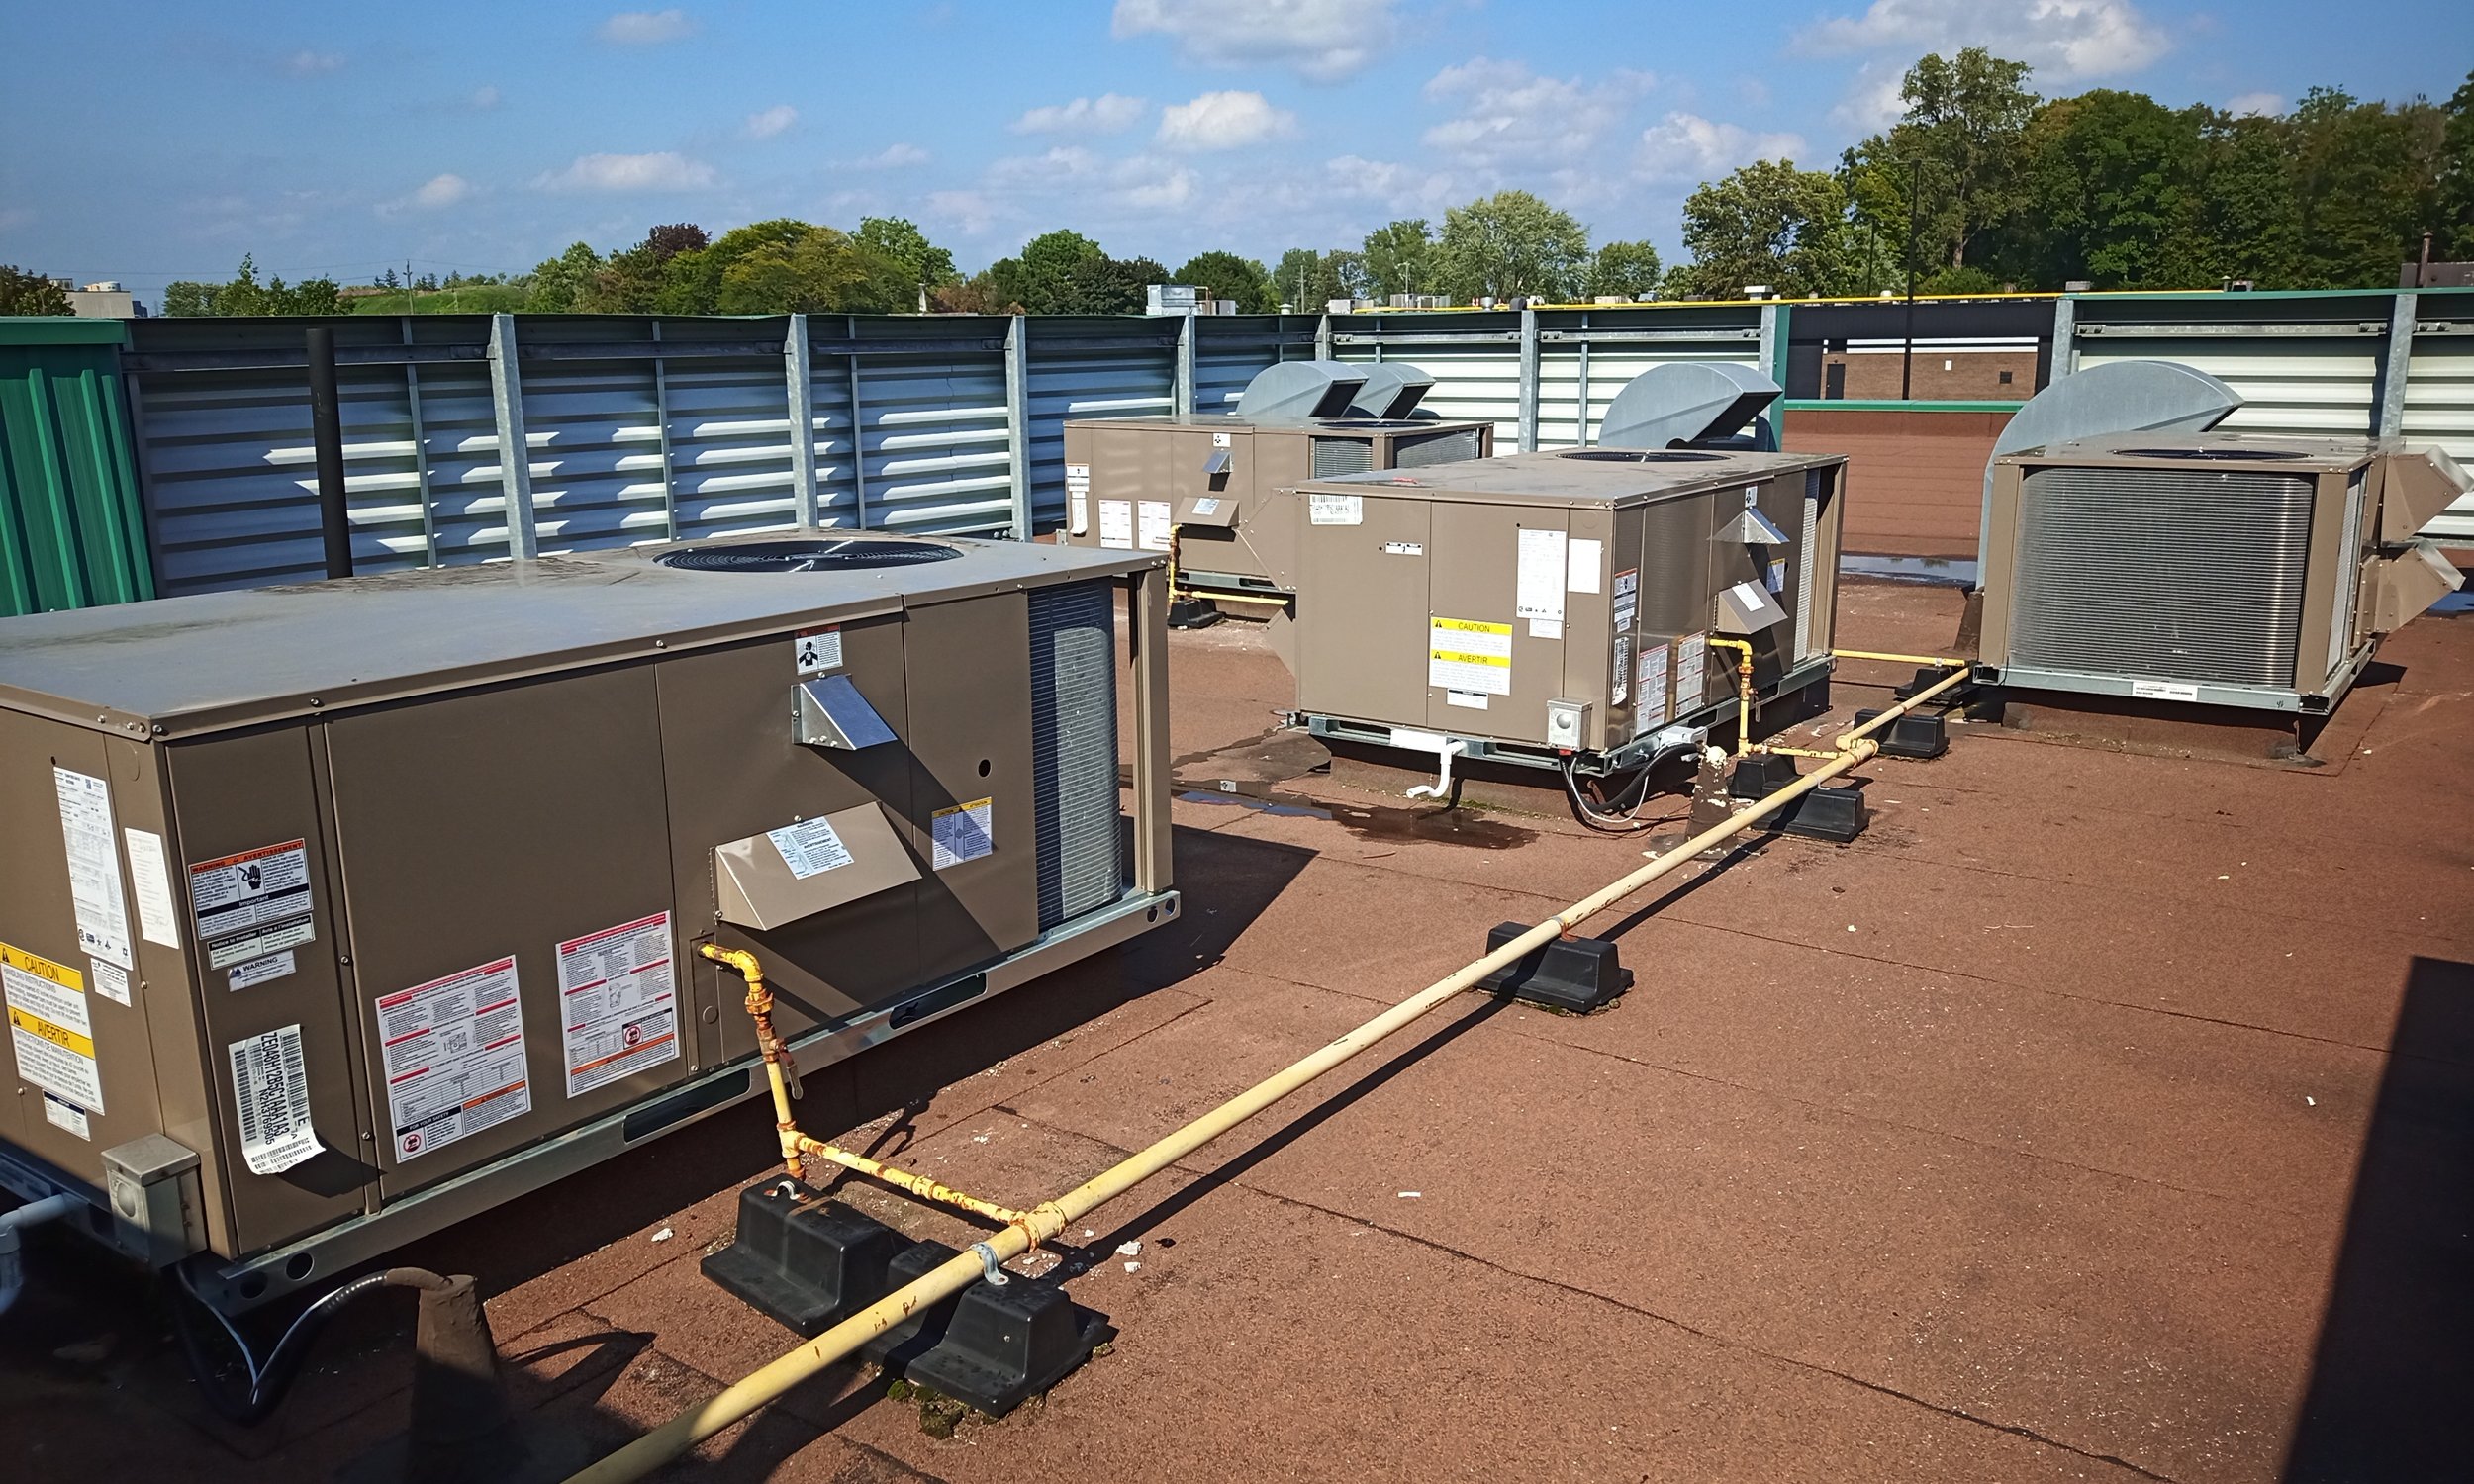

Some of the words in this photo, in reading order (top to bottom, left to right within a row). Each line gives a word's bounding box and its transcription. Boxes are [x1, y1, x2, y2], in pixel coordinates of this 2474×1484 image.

[1458, 622, 1490, 633] CAUTION
[1458, 654, 1488, 665] AVERTIR
[191, 860, 227, 873] WARNING
[243, 842, 303, 861] AVERTISSEMENT
[238, 894, 270, 907] Important
[211, 940, 229, 949] Notice
[25, 956, 60, 982] CAUTION
[242, 956, 278, 972] WARNING
[37, 1020, 71, 1048] AVERTIR
[258, 1088, 276, 1146] N2H3769505
[298, 1115, 310, 1127] E
[432, 1111, 450, 1122] SAFETY
